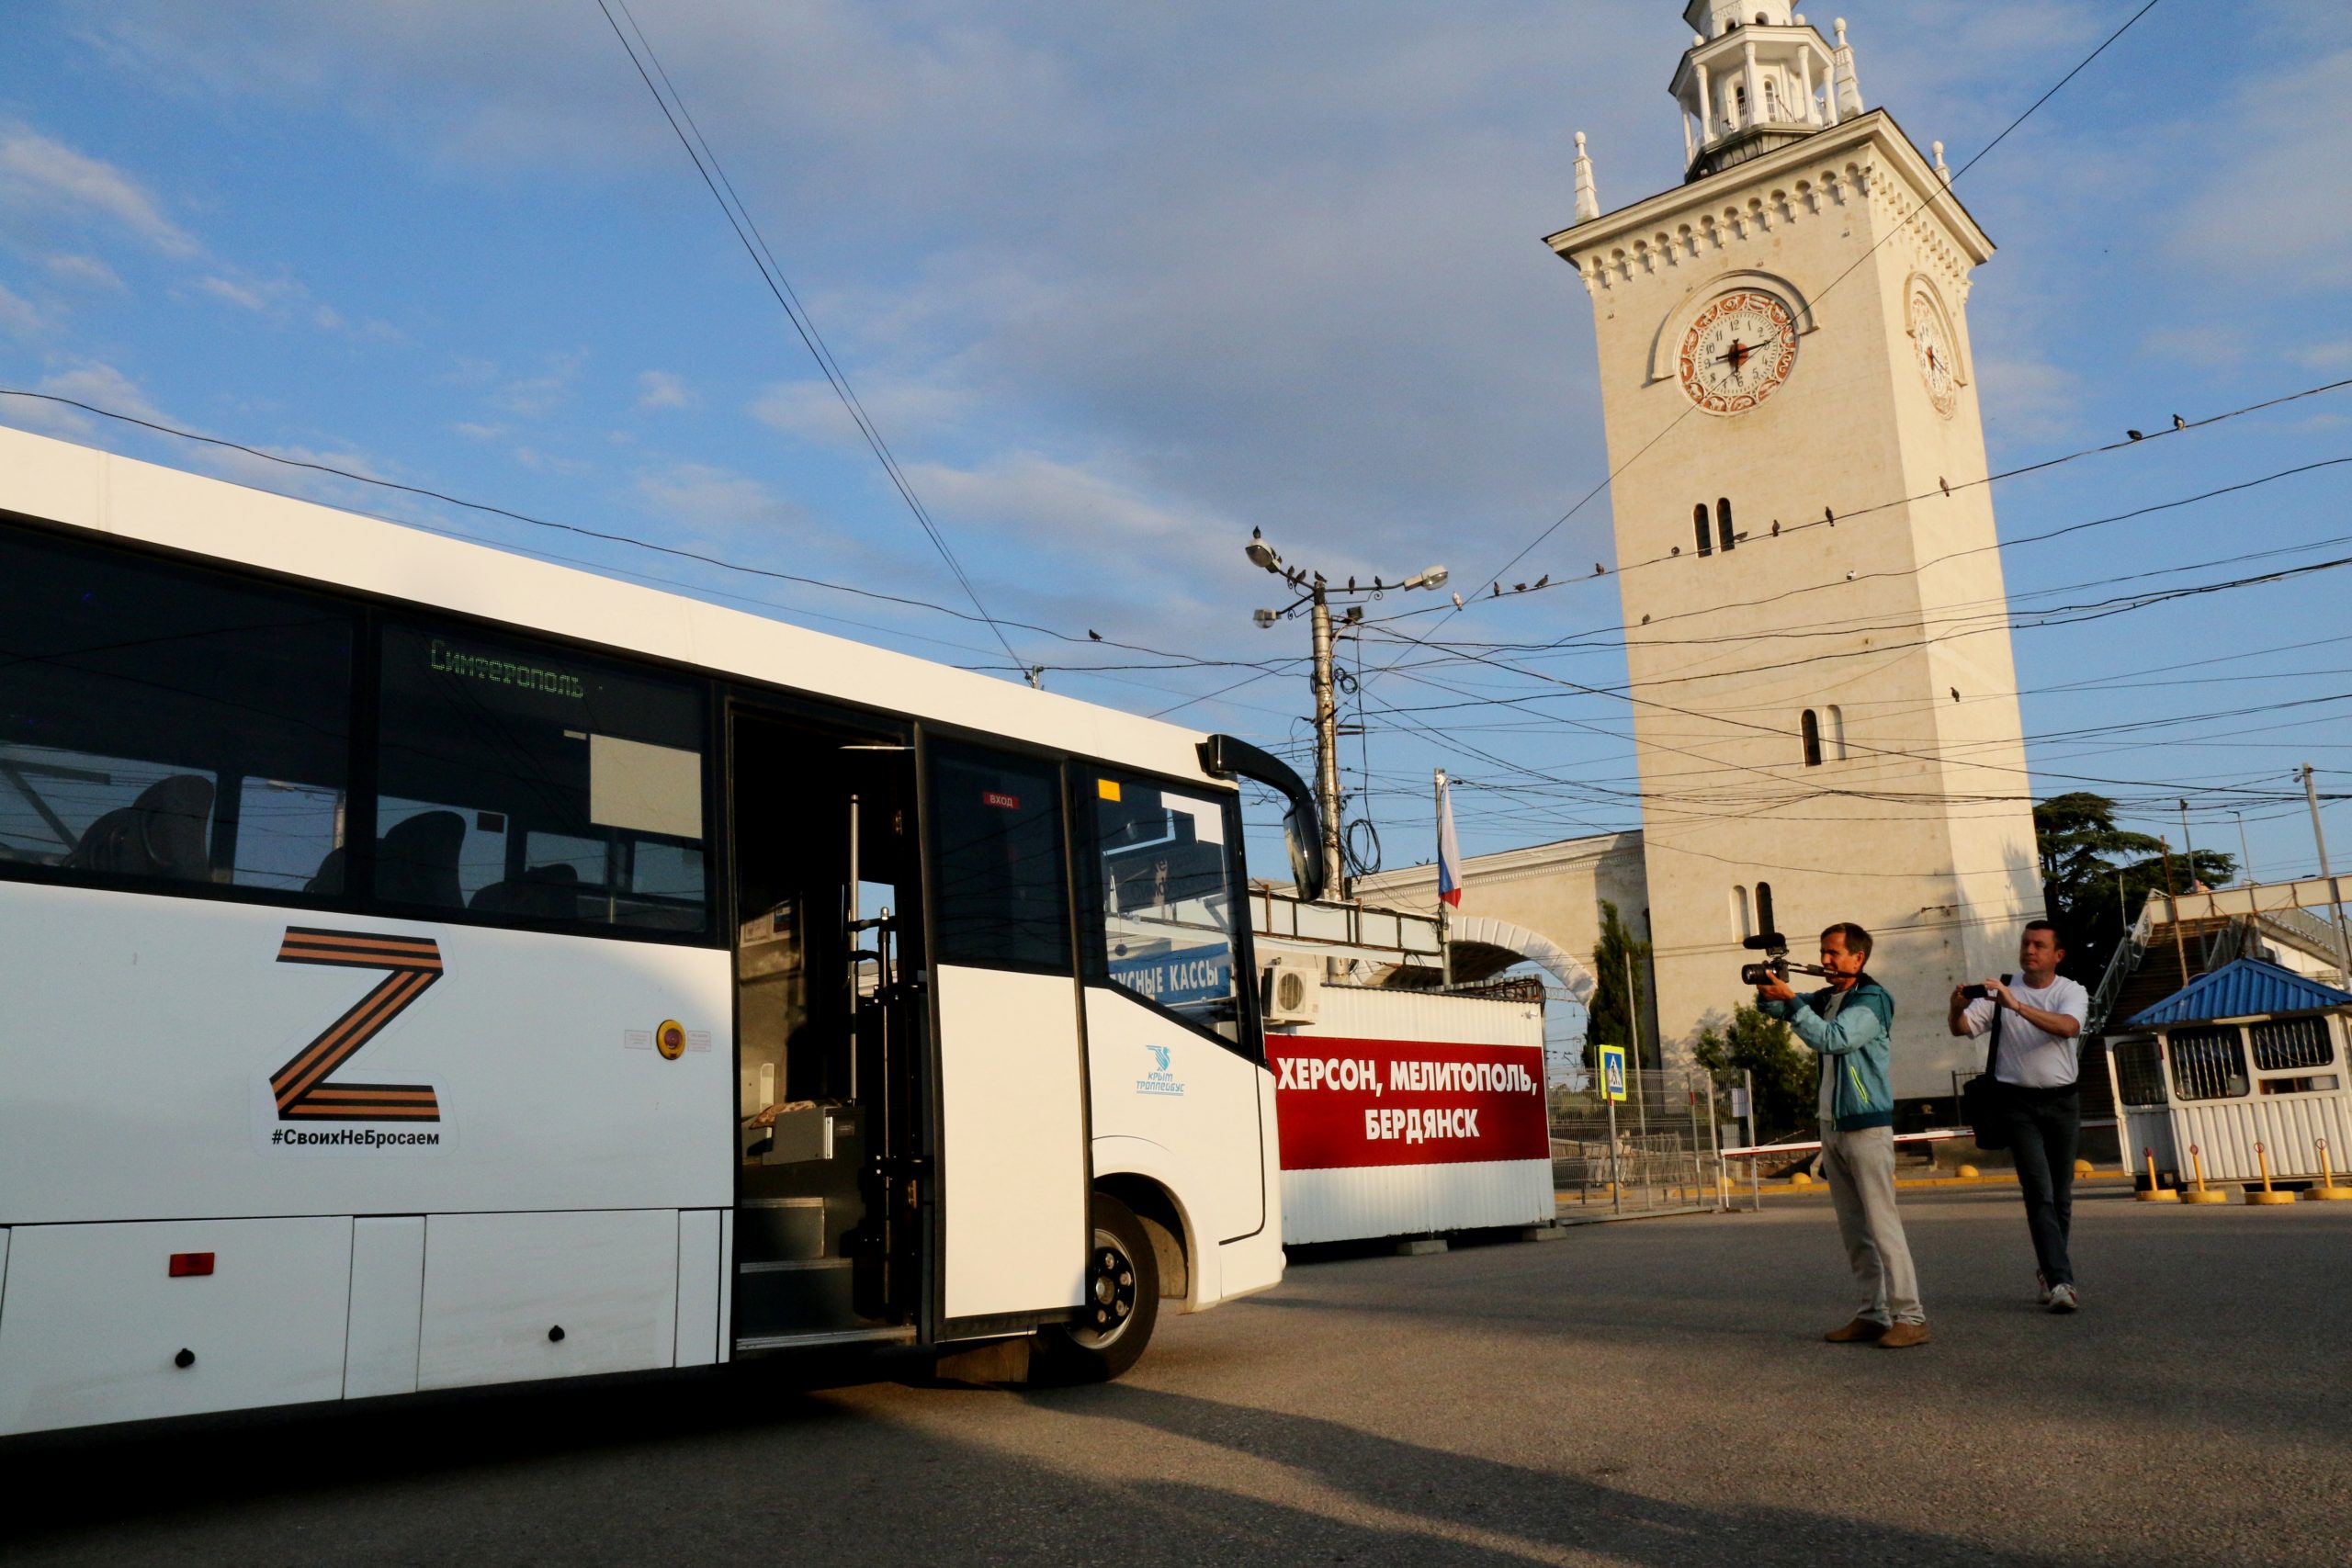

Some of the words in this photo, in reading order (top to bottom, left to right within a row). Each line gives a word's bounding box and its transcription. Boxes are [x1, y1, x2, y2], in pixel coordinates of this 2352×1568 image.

[1715, 330, 1723, 341] 11
[1730, 320, 1739, 331] 12
[1706, 343, 1714, 355] 10
[1703, 358, 1711, 369] 9
[431, 638, 583, 698] Симферополь
[989, 795, 1013, 807] ВХОД
[1110, 966, 1163, 995] УСНЫЕ
[1170, 960, 1218, 991] КАССЫ
[270, 926, 444, 1122] Z
[1276, 1057, 1383, 1097] ХЕРСОН,
[1390, 1061, 1537, 1096] МЕЛИТОПОЛЬ,
[1364, 1109, 1480, 1145] БЕРДЯНСК
[271, 1128, 440, 1149] #СвоихНеБросаем
